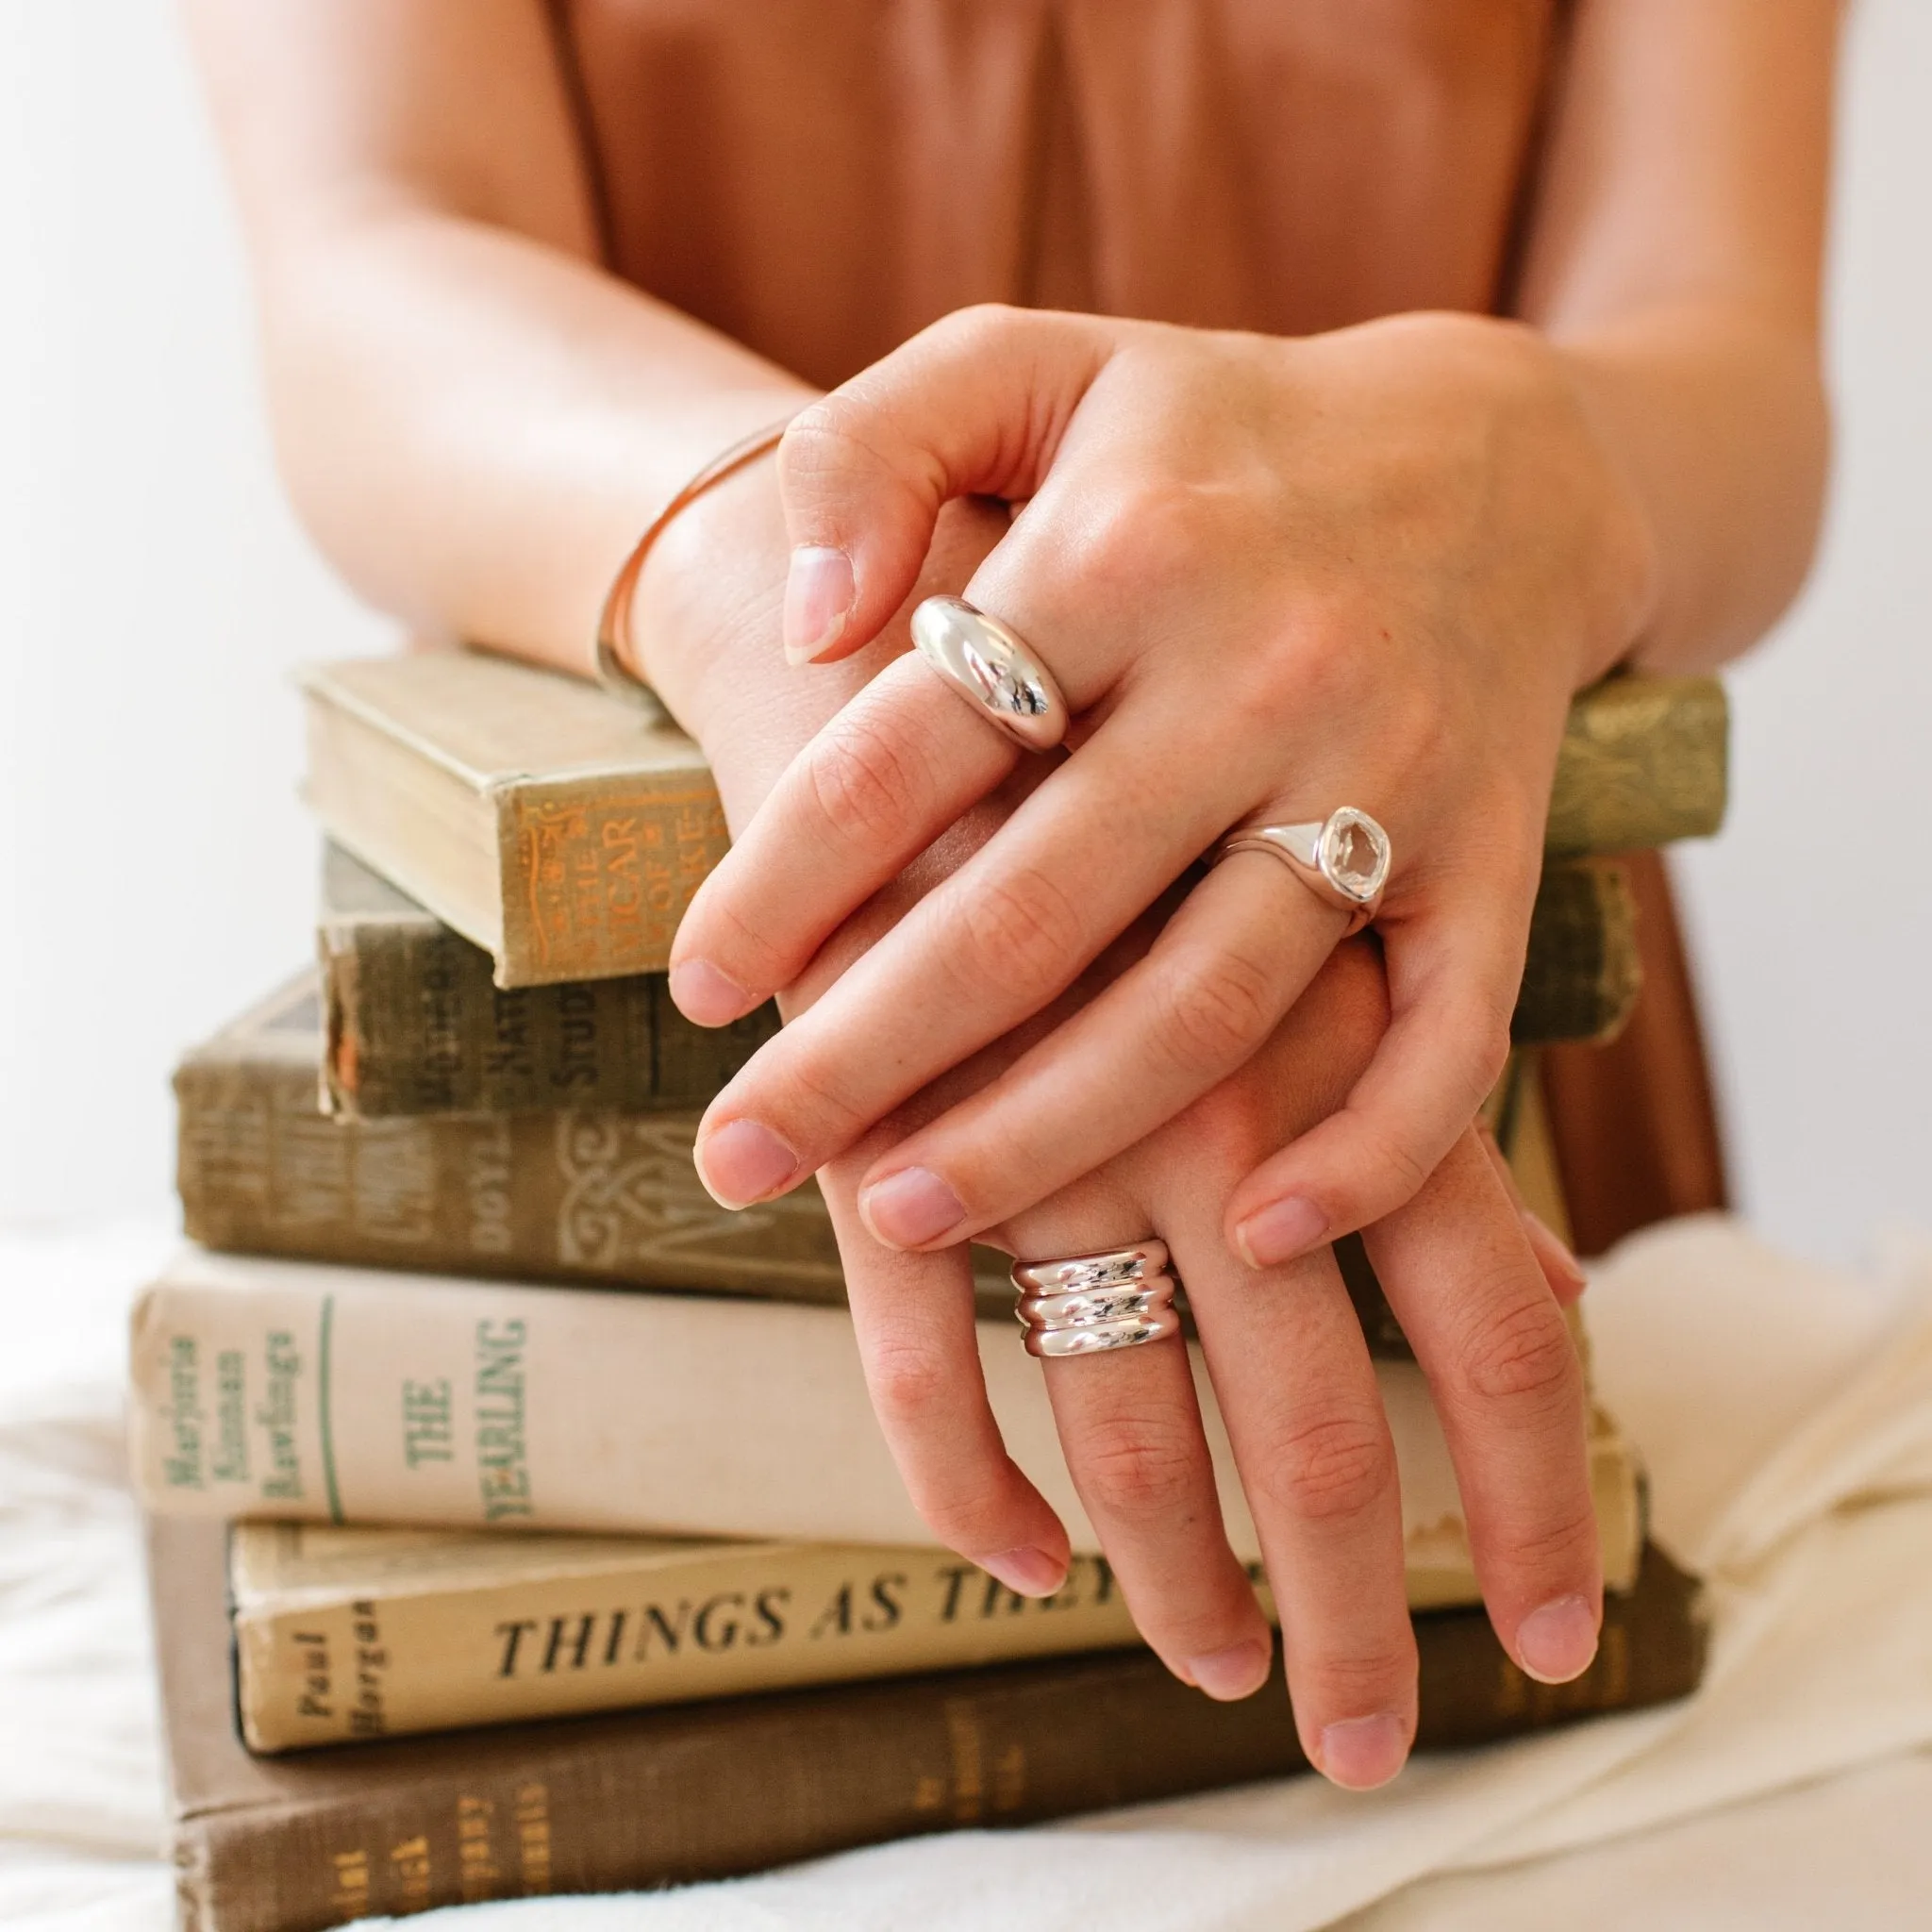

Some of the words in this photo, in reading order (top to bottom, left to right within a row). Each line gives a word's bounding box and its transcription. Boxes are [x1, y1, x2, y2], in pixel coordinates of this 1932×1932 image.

[402, 1378, 455, 1470] THE
[475, 1318, 534, 1522] YEARLING
[494, 1589, 791, 1677] THINGS
[809, 1572, 908, 1641] AS
[291, 1631, 332, 1718] Paul
